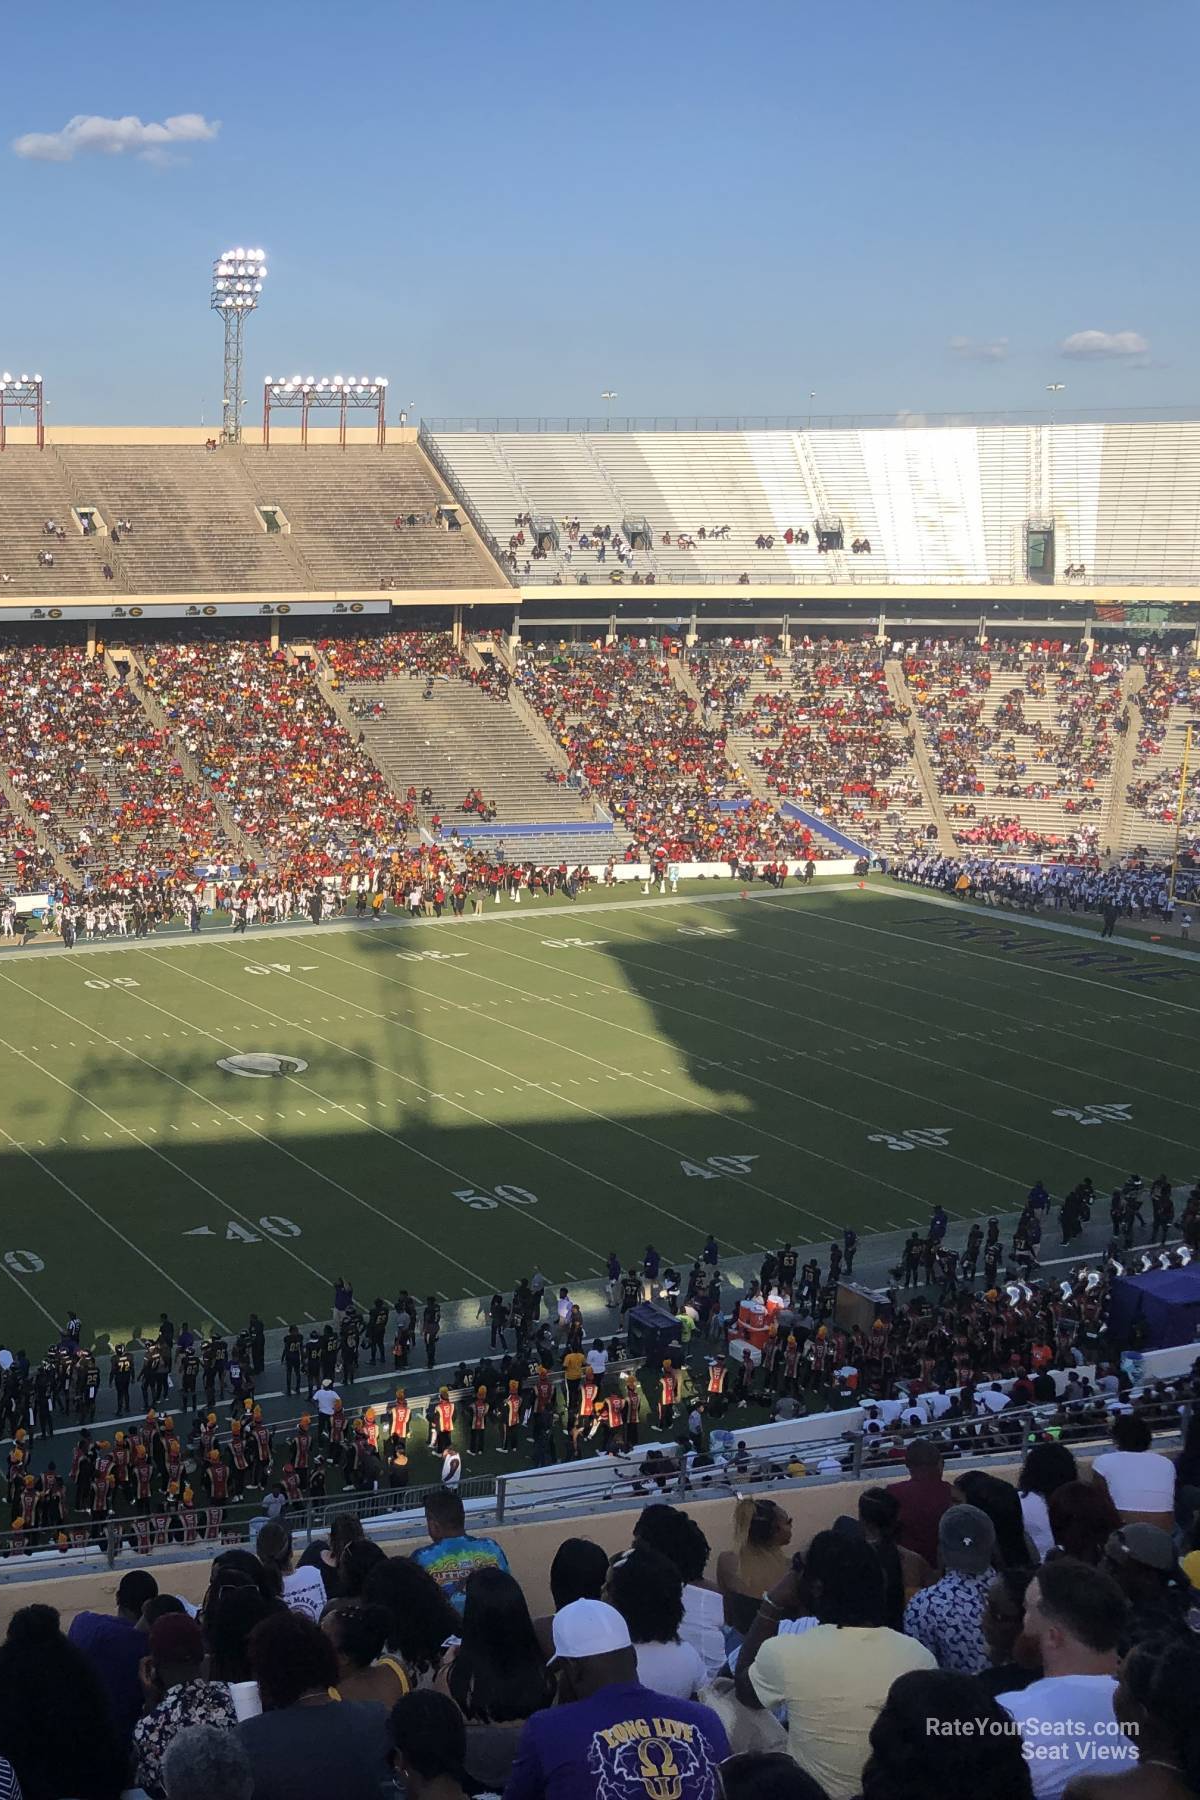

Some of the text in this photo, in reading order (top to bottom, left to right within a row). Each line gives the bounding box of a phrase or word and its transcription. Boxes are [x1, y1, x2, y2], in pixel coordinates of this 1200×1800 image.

[541, 938, 594, 948] 20
[894, 916, 1200, 985] PRAIRIE
[395, 950, 450, 961] 30
[244, 963, 291, 975] 40
[84, 977, 141, 989] 50
[1052, 1105, 1133, 1125] 20
[867, 1129, 949, 1151] 30
[680, 1156, 752, 1179] 40
[451, 1184, 539, 1209] 50
[225, 1216, 302, 1243] 40
[118, 1361, 130, 1372] 72
[600, 1718, 694, 1748] LONG LIVE
